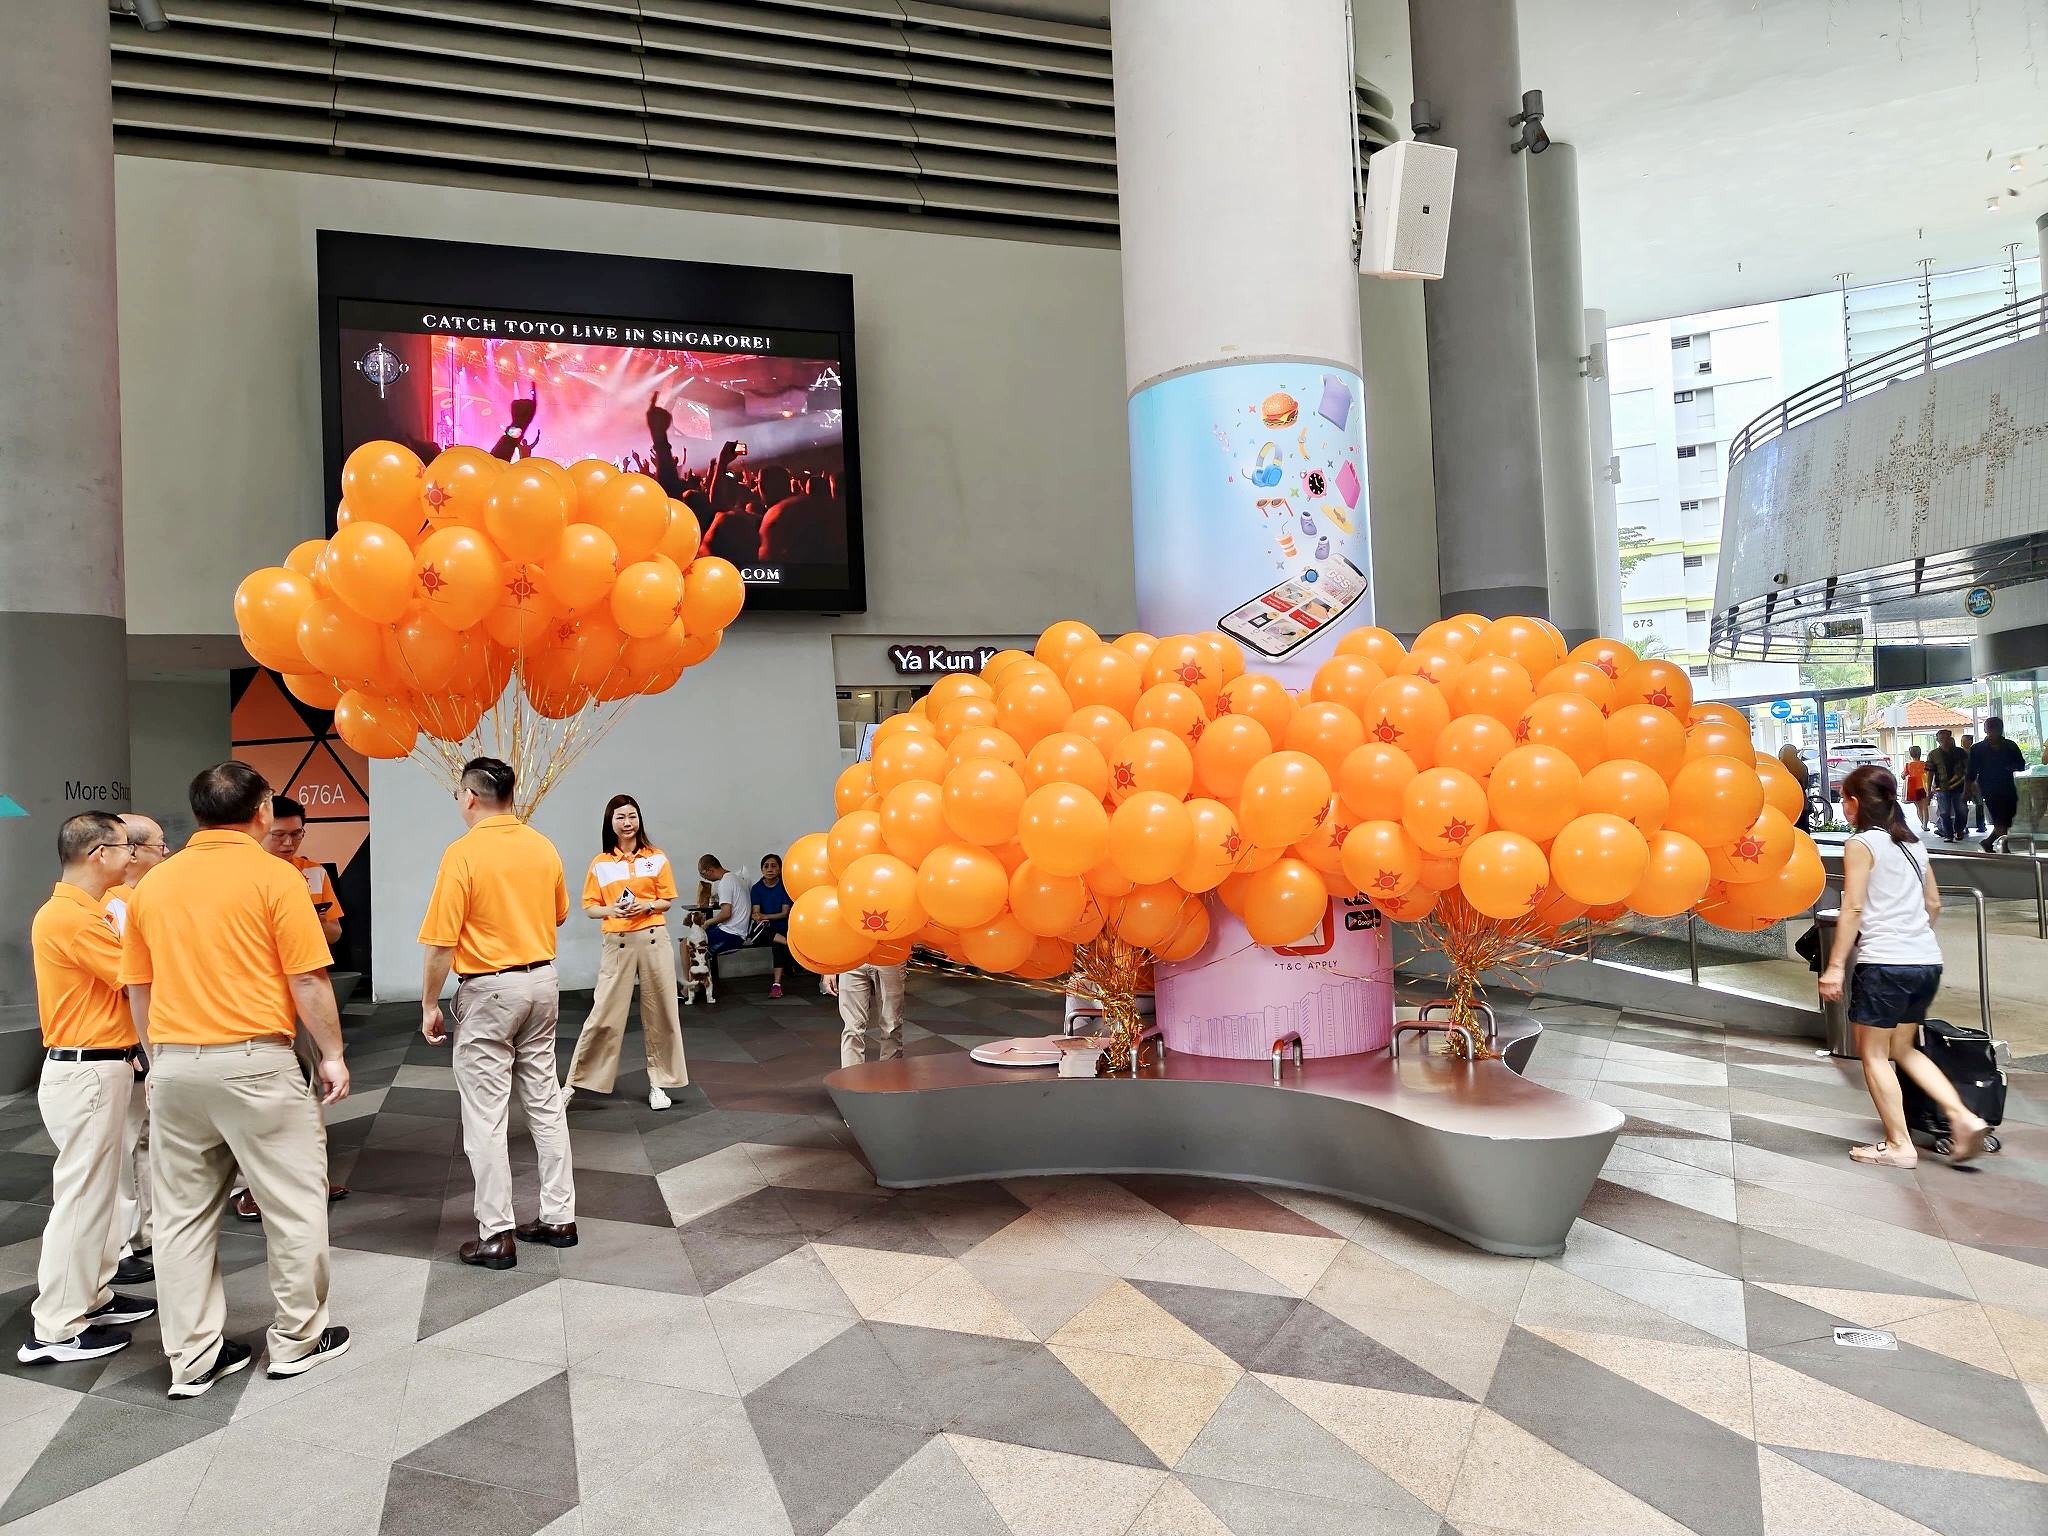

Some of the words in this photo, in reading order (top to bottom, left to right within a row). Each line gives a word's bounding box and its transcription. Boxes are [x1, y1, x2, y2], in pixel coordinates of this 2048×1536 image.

[422, 314, 497, 332] CATCH
[504, 319, 565, 336] TOTO
[572, 324, 618, 340] LIVE
[625, 328, 645, 341] IN
[652, 329, 771, 349] SINGAPORE!
[1632, 618, 1654, 629] 673
[894, 649, 923, 670] Ya
[928, 650, 974, 670] Kun
[65, 781, 107, 800] More
[298, 784, 346, 805] 676A
[1308, 960, 1338, 969] APPLY
